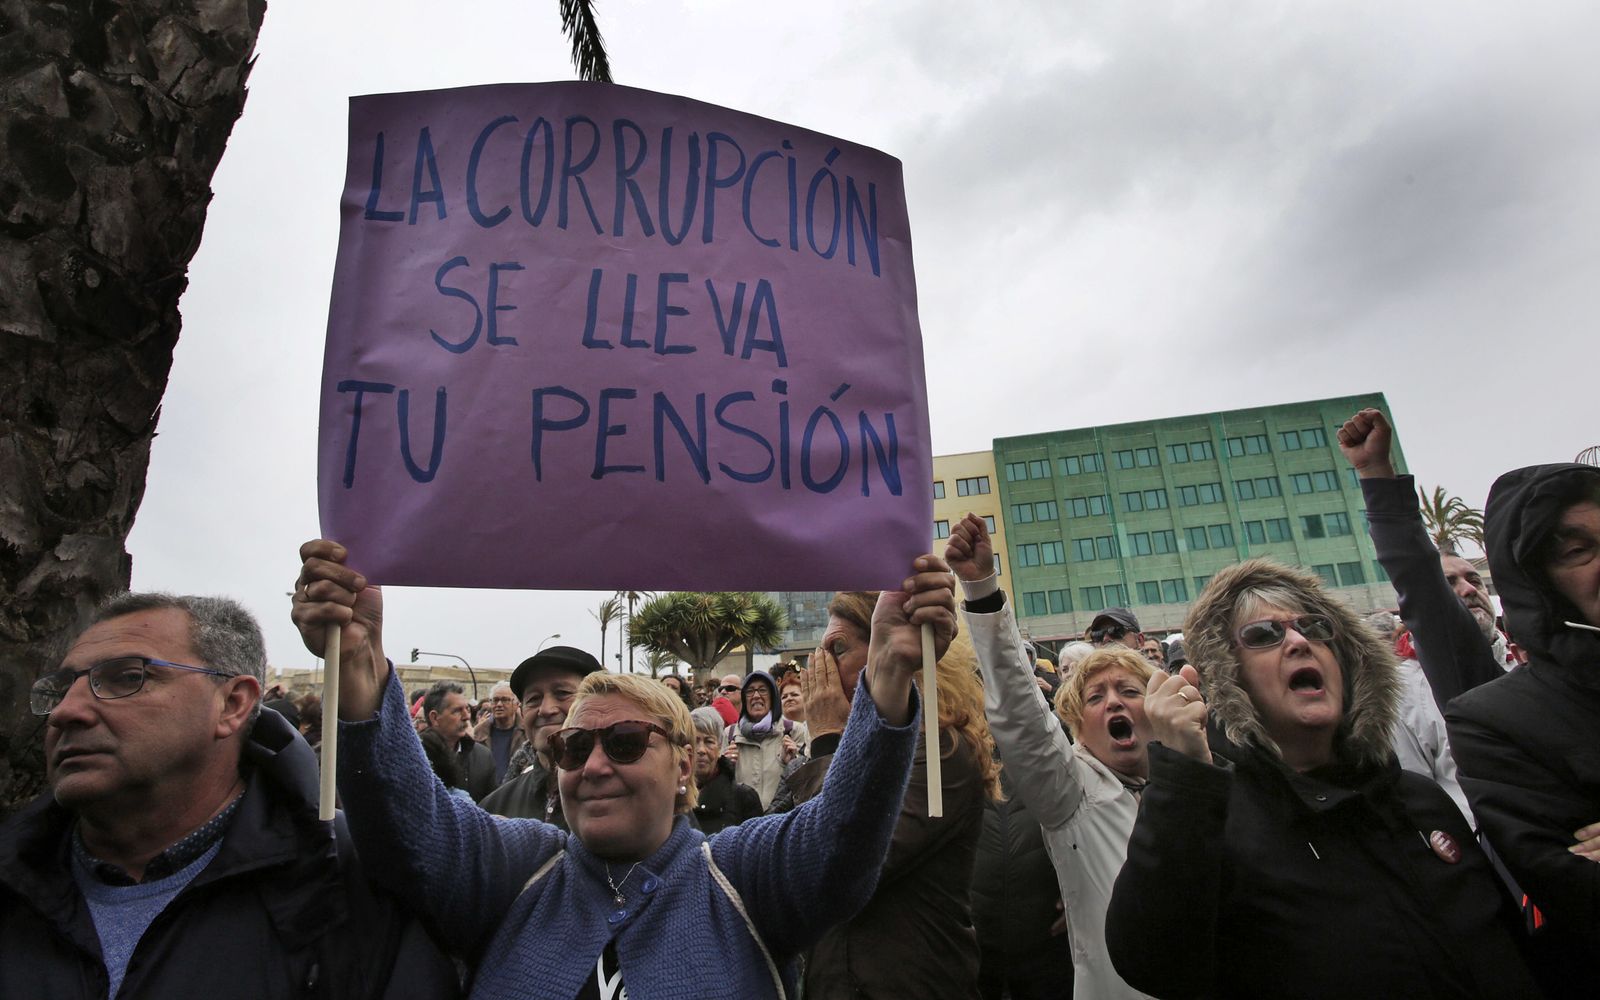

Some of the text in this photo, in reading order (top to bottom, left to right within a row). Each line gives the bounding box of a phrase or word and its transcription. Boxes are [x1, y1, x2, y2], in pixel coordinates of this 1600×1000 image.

[364, 126, 447, 226] LA
[430, 256, 788, 368] SE LLEVA
[337, 380, 447, 489] TU
